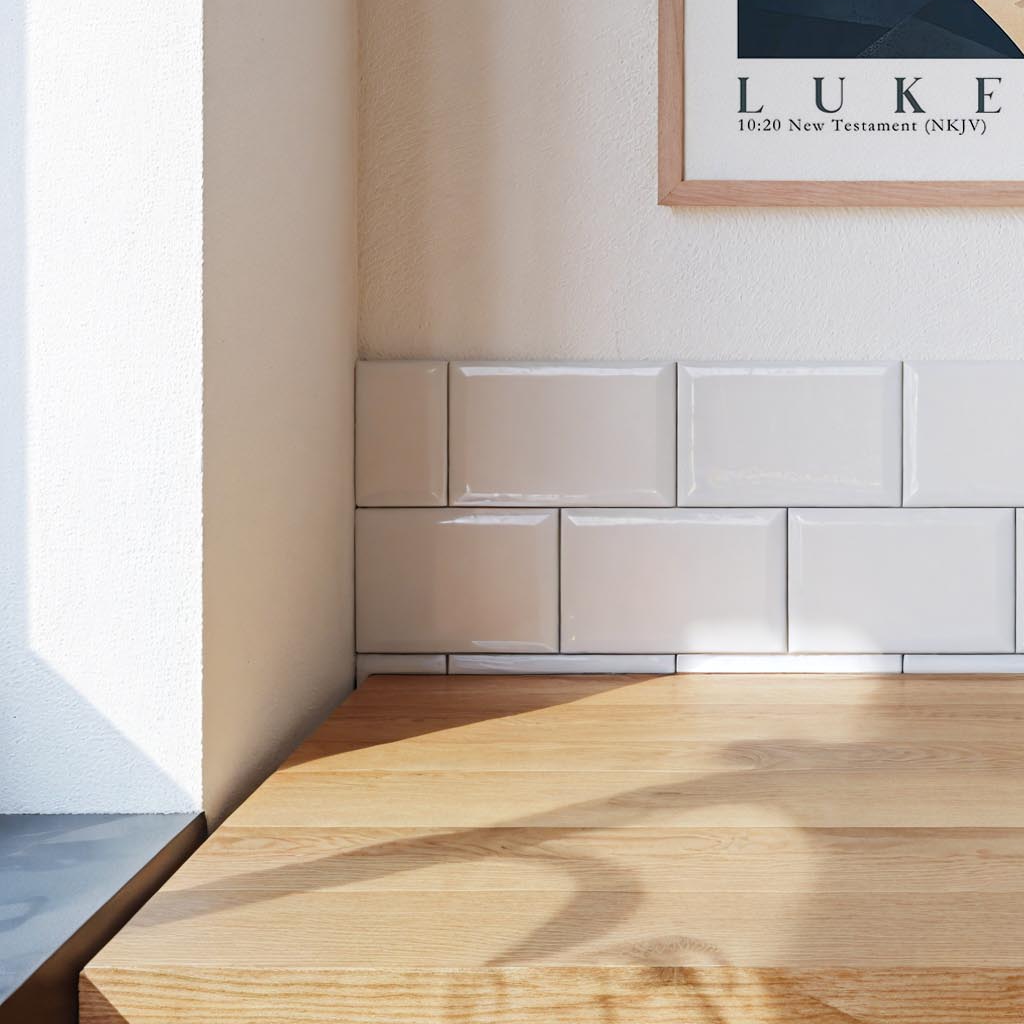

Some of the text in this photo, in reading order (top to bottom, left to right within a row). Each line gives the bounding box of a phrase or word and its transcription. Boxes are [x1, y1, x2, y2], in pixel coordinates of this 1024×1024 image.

[737, 76, 1003, 114] LUKE
[738, 118, 987, 136] 10:20 New Testament (NKJV)
